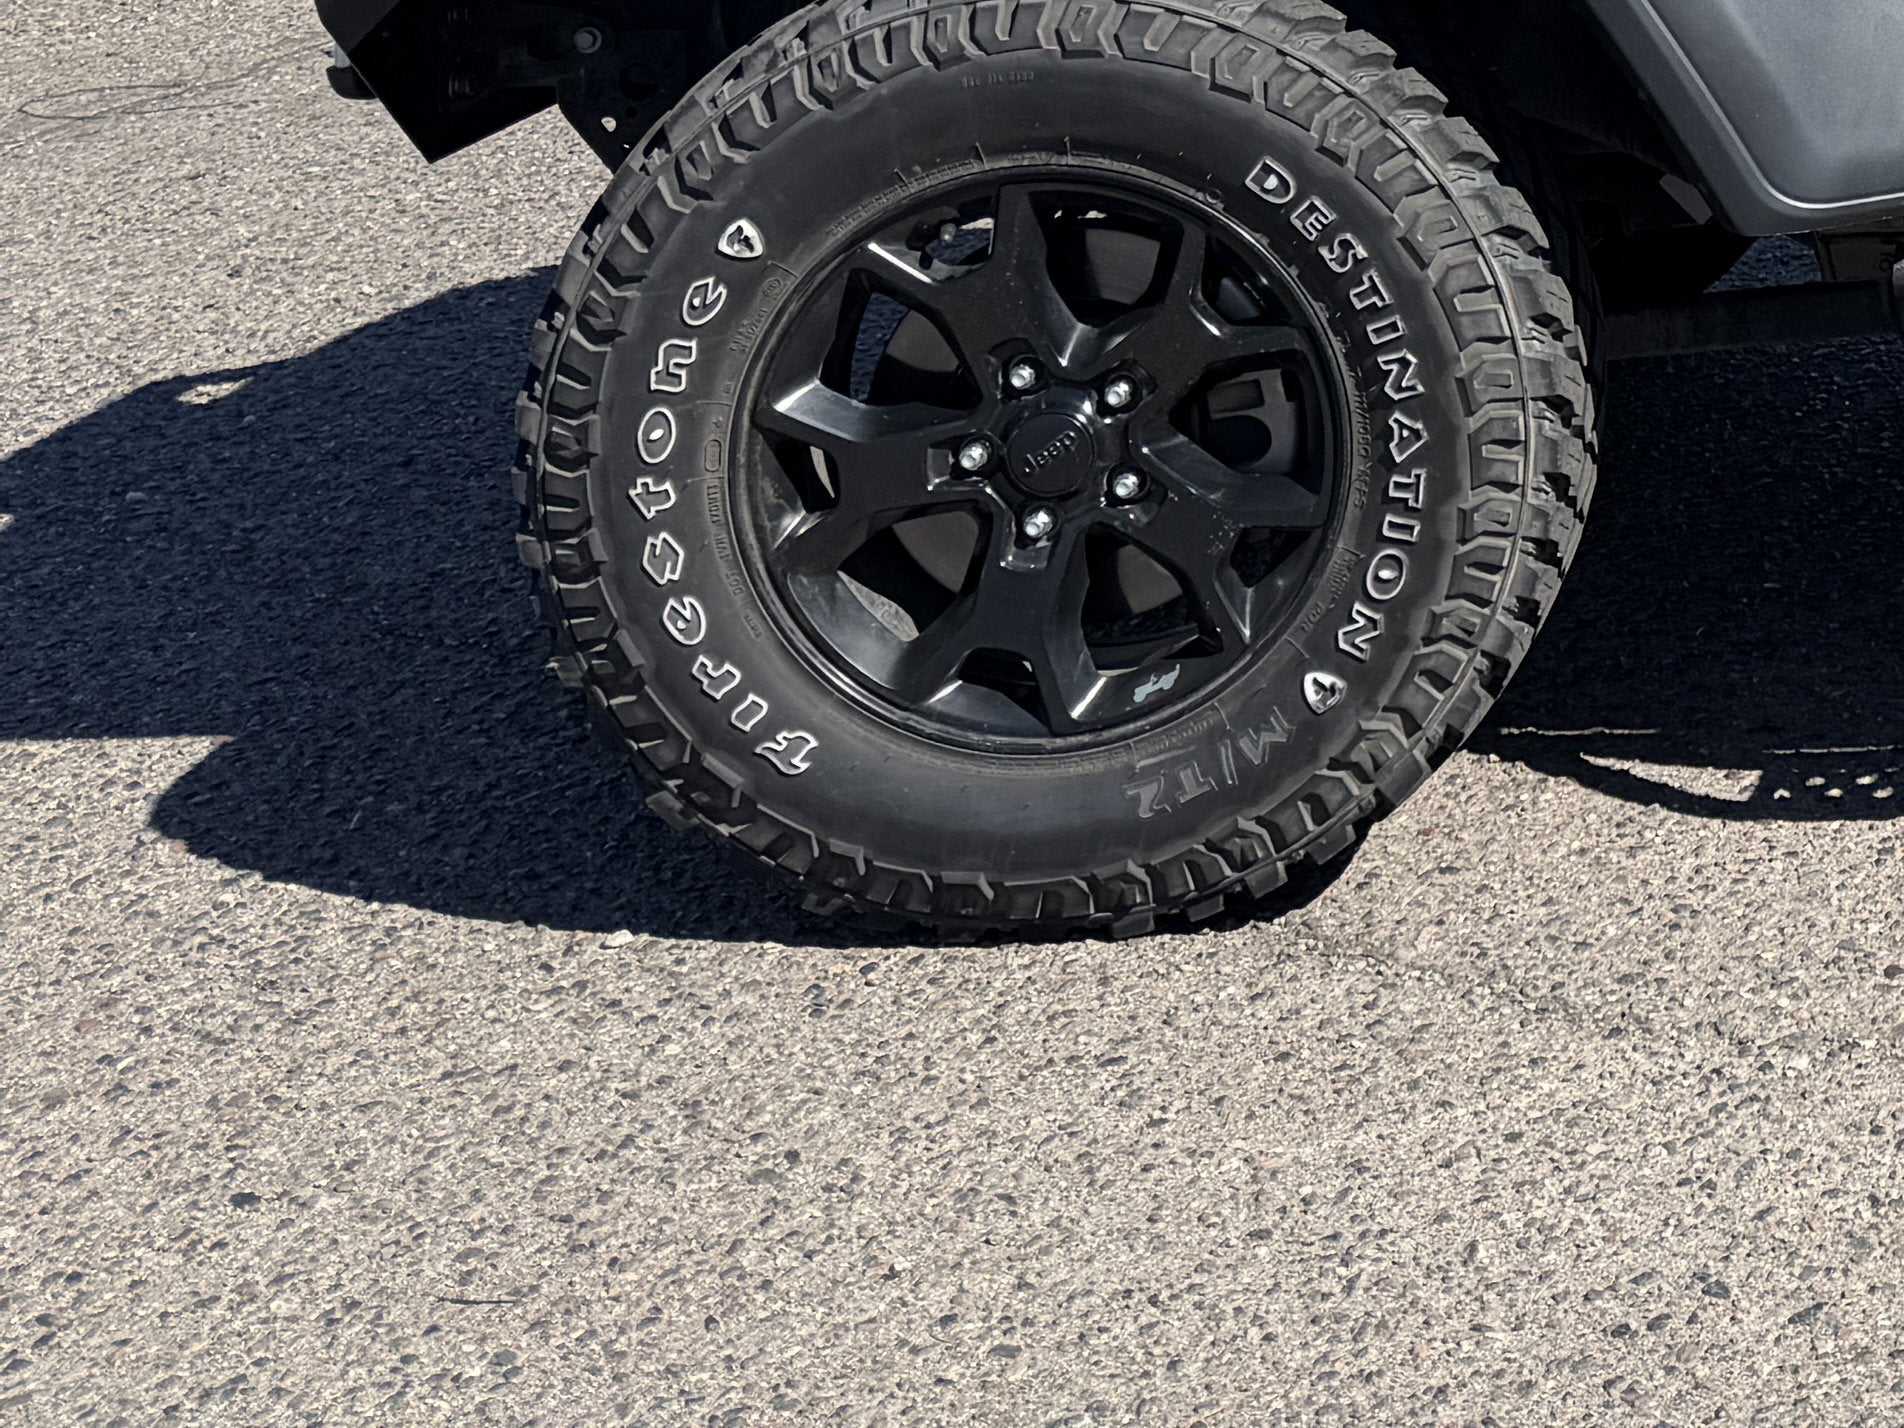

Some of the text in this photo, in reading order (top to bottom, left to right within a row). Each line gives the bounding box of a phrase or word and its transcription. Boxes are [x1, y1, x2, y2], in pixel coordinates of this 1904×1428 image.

[629, 277, 818, 775] Firestone
[1023, 430, 1079, 473] Jeep
[1245, 156, 1429, 662] DESTINATION
